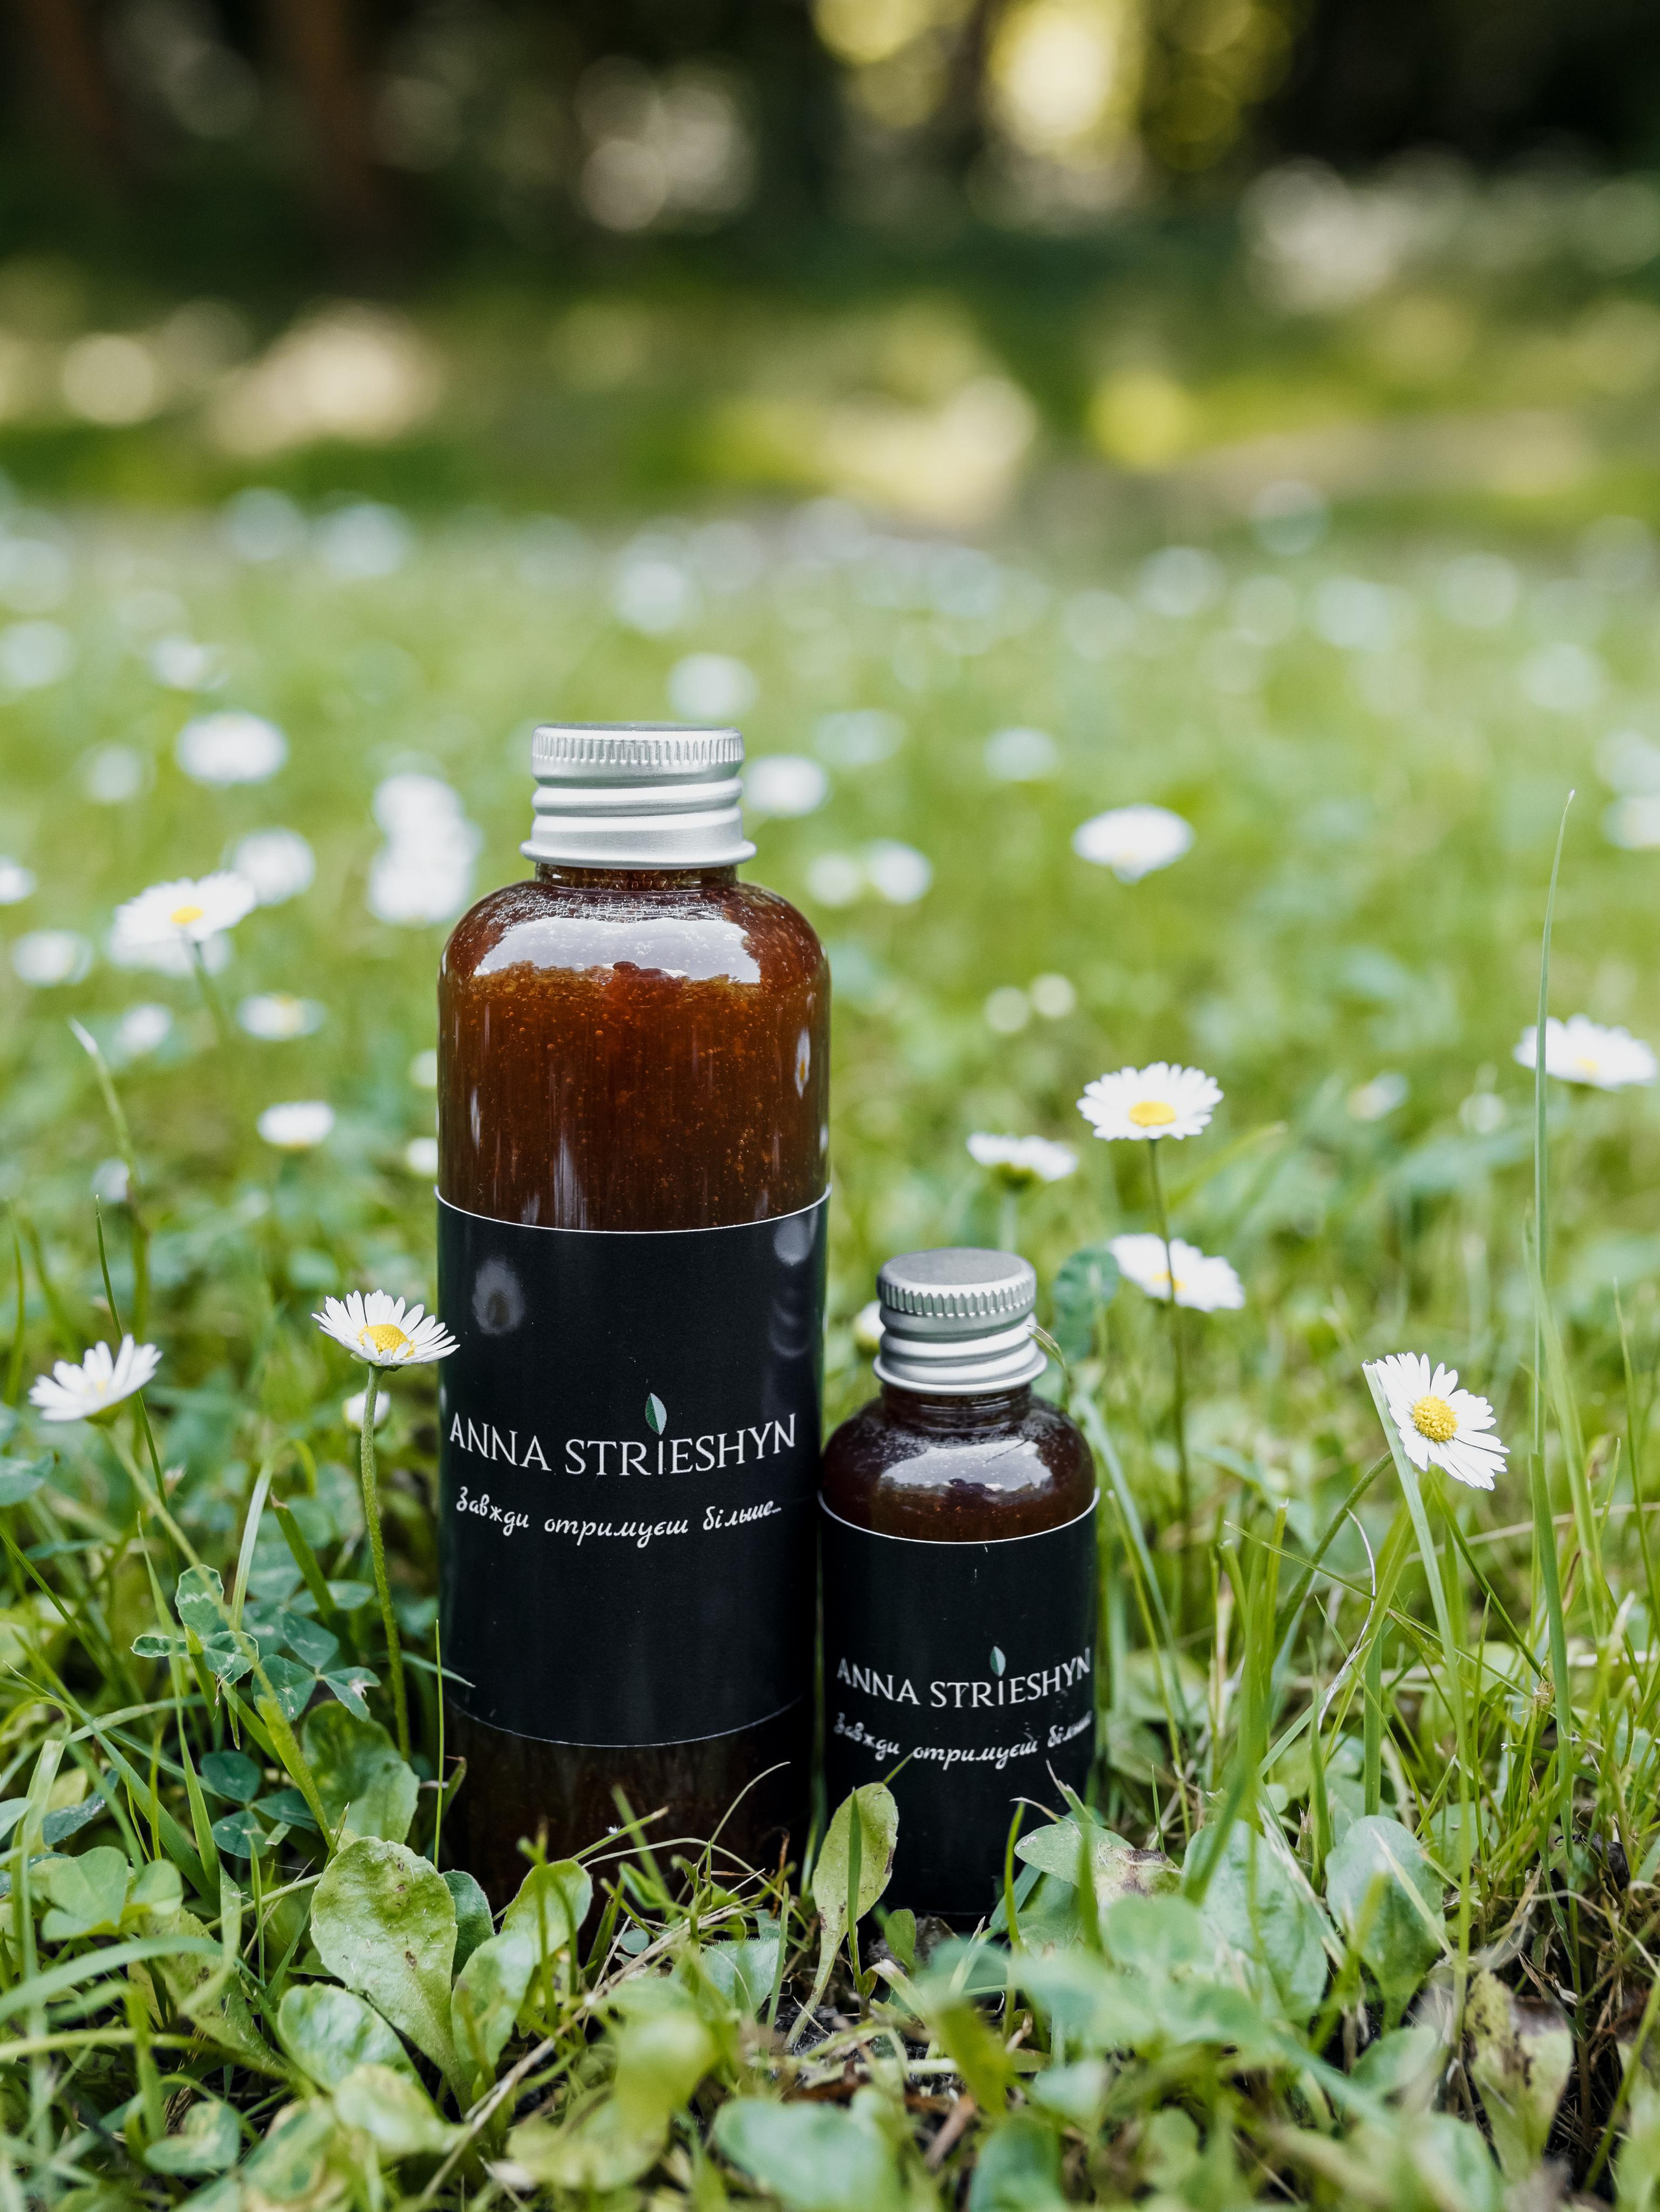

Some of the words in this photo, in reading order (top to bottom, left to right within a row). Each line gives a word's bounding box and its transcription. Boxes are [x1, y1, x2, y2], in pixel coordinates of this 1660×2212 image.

[449, 1412, 552, 1472] ANNA
[565, 1413, 797, 1476] STRIESHYN
[456, 1486, 529, 1537] Завжди
[545, 1518, 688, 1548] отримуєш
[837, 1658, 921, 1706] ANNA
[931, 1647, 1090, 1708] STRIESHYN
[913, 1739, 1038, 1771] отримуєш
